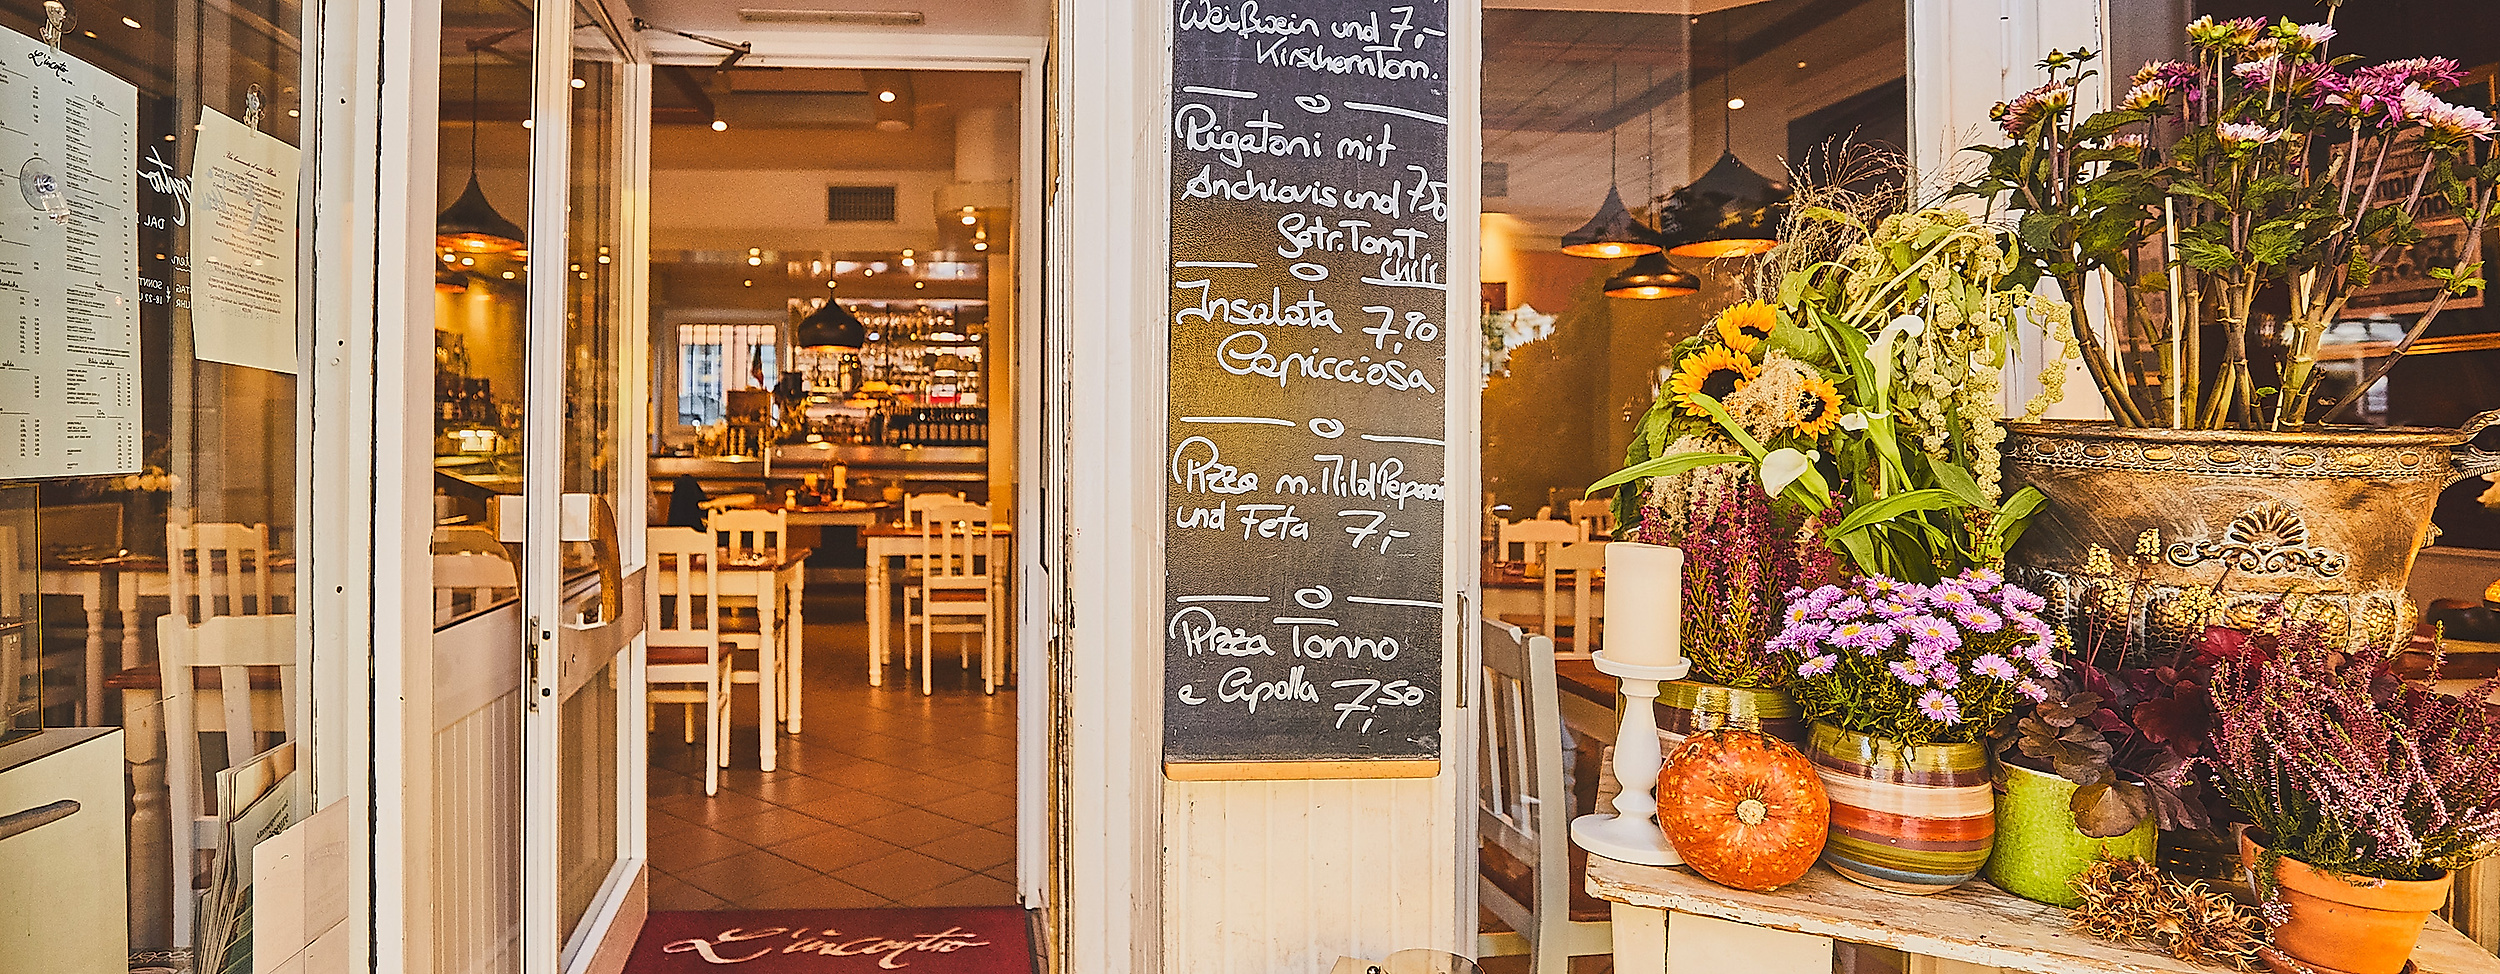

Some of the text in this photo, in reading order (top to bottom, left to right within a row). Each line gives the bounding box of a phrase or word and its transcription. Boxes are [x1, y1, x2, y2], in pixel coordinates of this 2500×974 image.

[1330, 11, 1380, 44] und
[1175, 103, 1397, 168] Rigatoni mit
[1343, 180, 1401, 220] und
[1176, 279, 1343, 334] Insalata
[1177, 500, 1226, 531] und
[1236, 504, 1309, 541] Feta
[1273, 616, 1400, 661] Tonno
[1178, 683, 1207, 705] e
